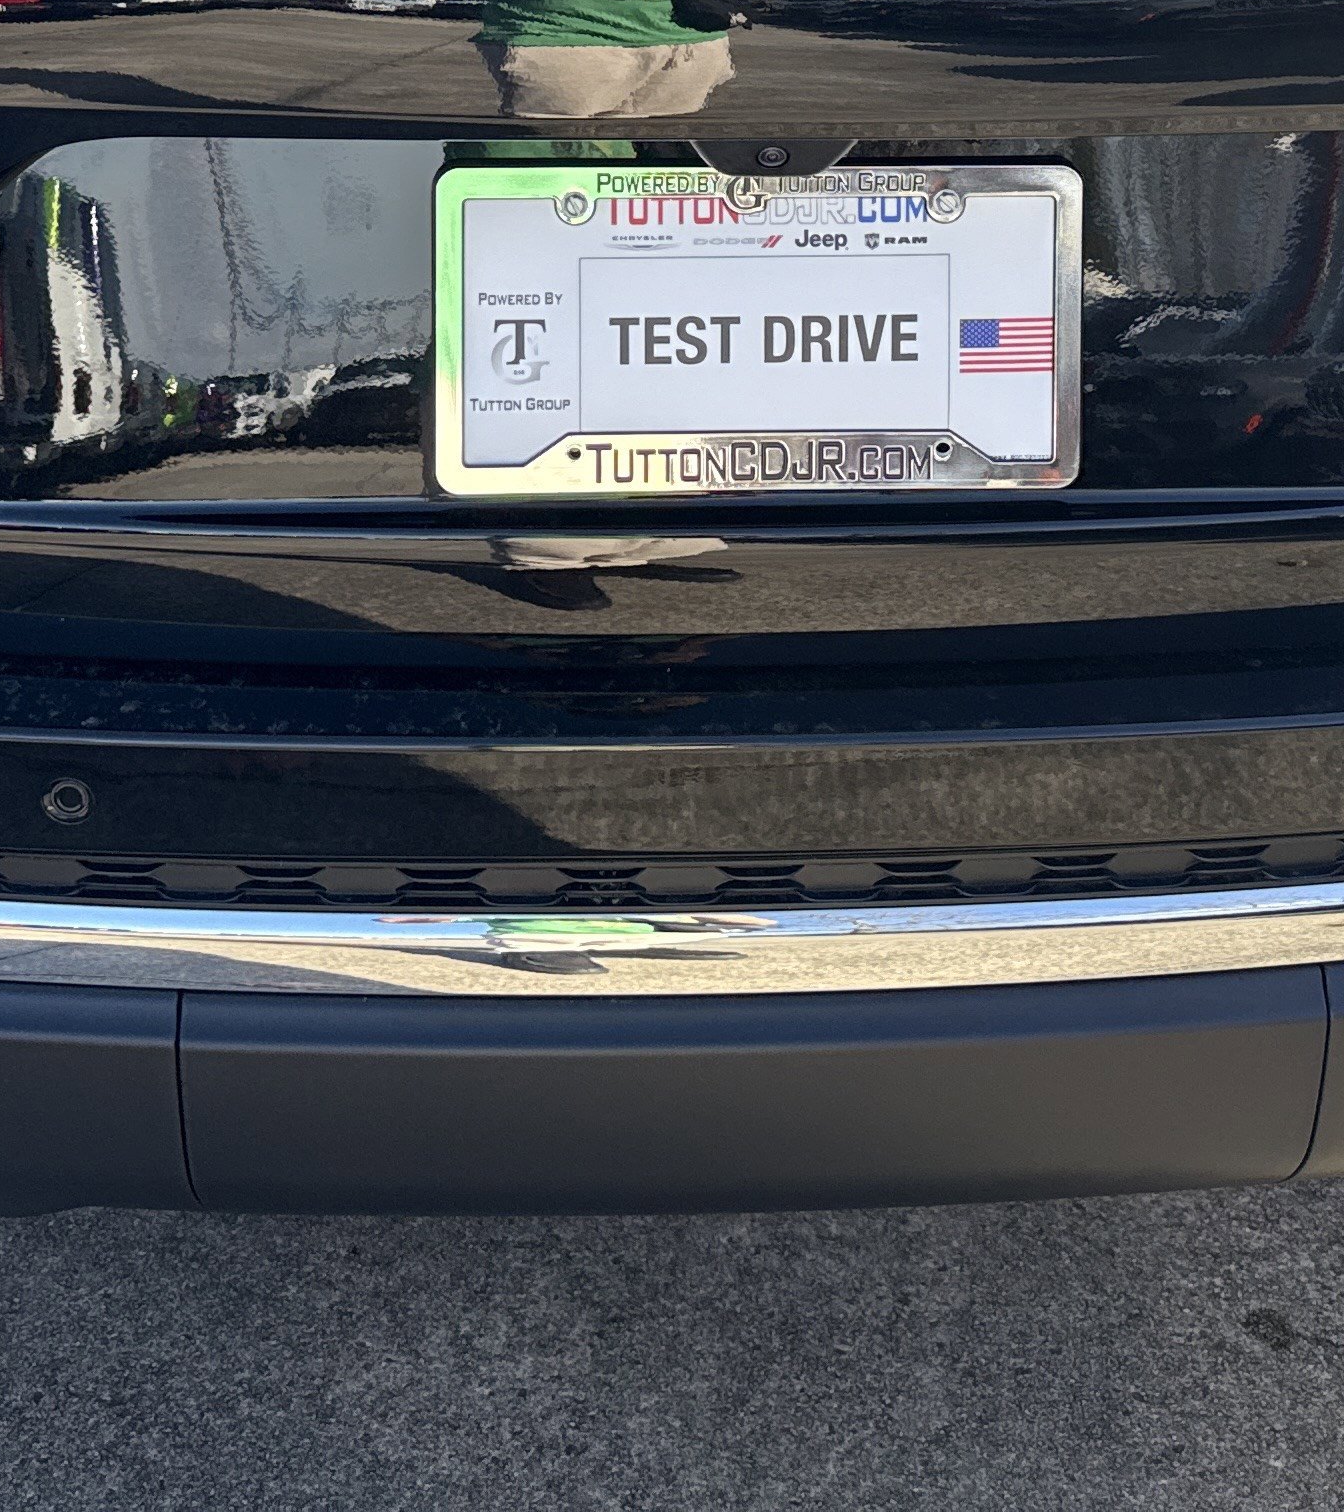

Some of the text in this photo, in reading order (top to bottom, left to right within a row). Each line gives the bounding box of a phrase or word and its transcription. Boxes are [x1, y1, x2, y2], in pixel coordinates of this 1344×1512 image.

[596, 172, 690, 194] POWERED
[858, 172, 926, 192] GROUP
[795, 229, 848, 251] Jeep
[884, 235, 928, 245] RAM
[608, 313, 919, 365] TEST DRIVE
[469, 397, 571, 412] TUTTON GROUP
[585, 439, 934, 484] TUTTONCDJR.COM
